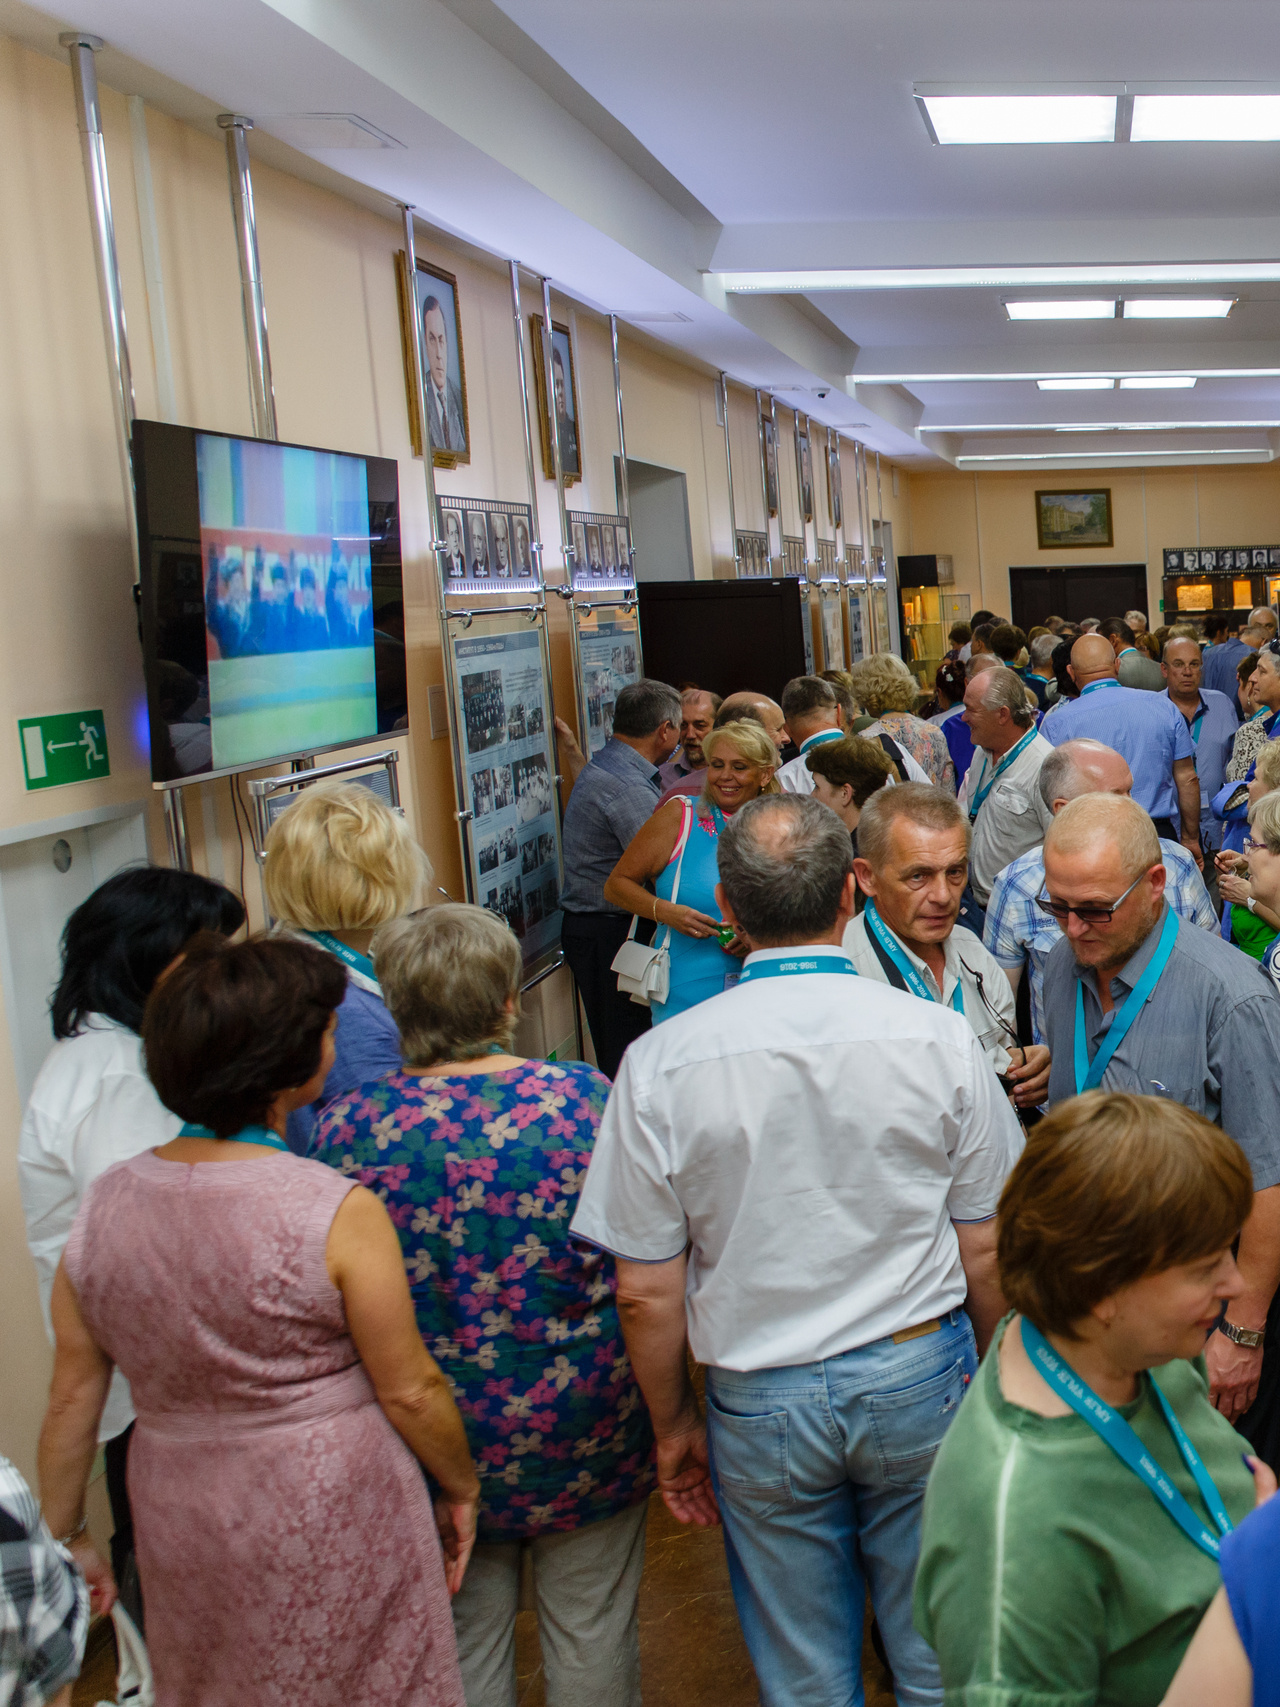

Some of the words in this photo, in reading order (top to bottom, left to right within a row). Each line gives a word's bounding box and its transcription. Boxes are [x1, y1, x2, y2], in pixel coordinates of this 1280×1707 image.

[869, 907, 898, 953] ЯМИ-ЯГМА-ЯГМУ
[779, 961, 818, 972] 1986-2016
[907, 971, 928, 998] 1986-2016
